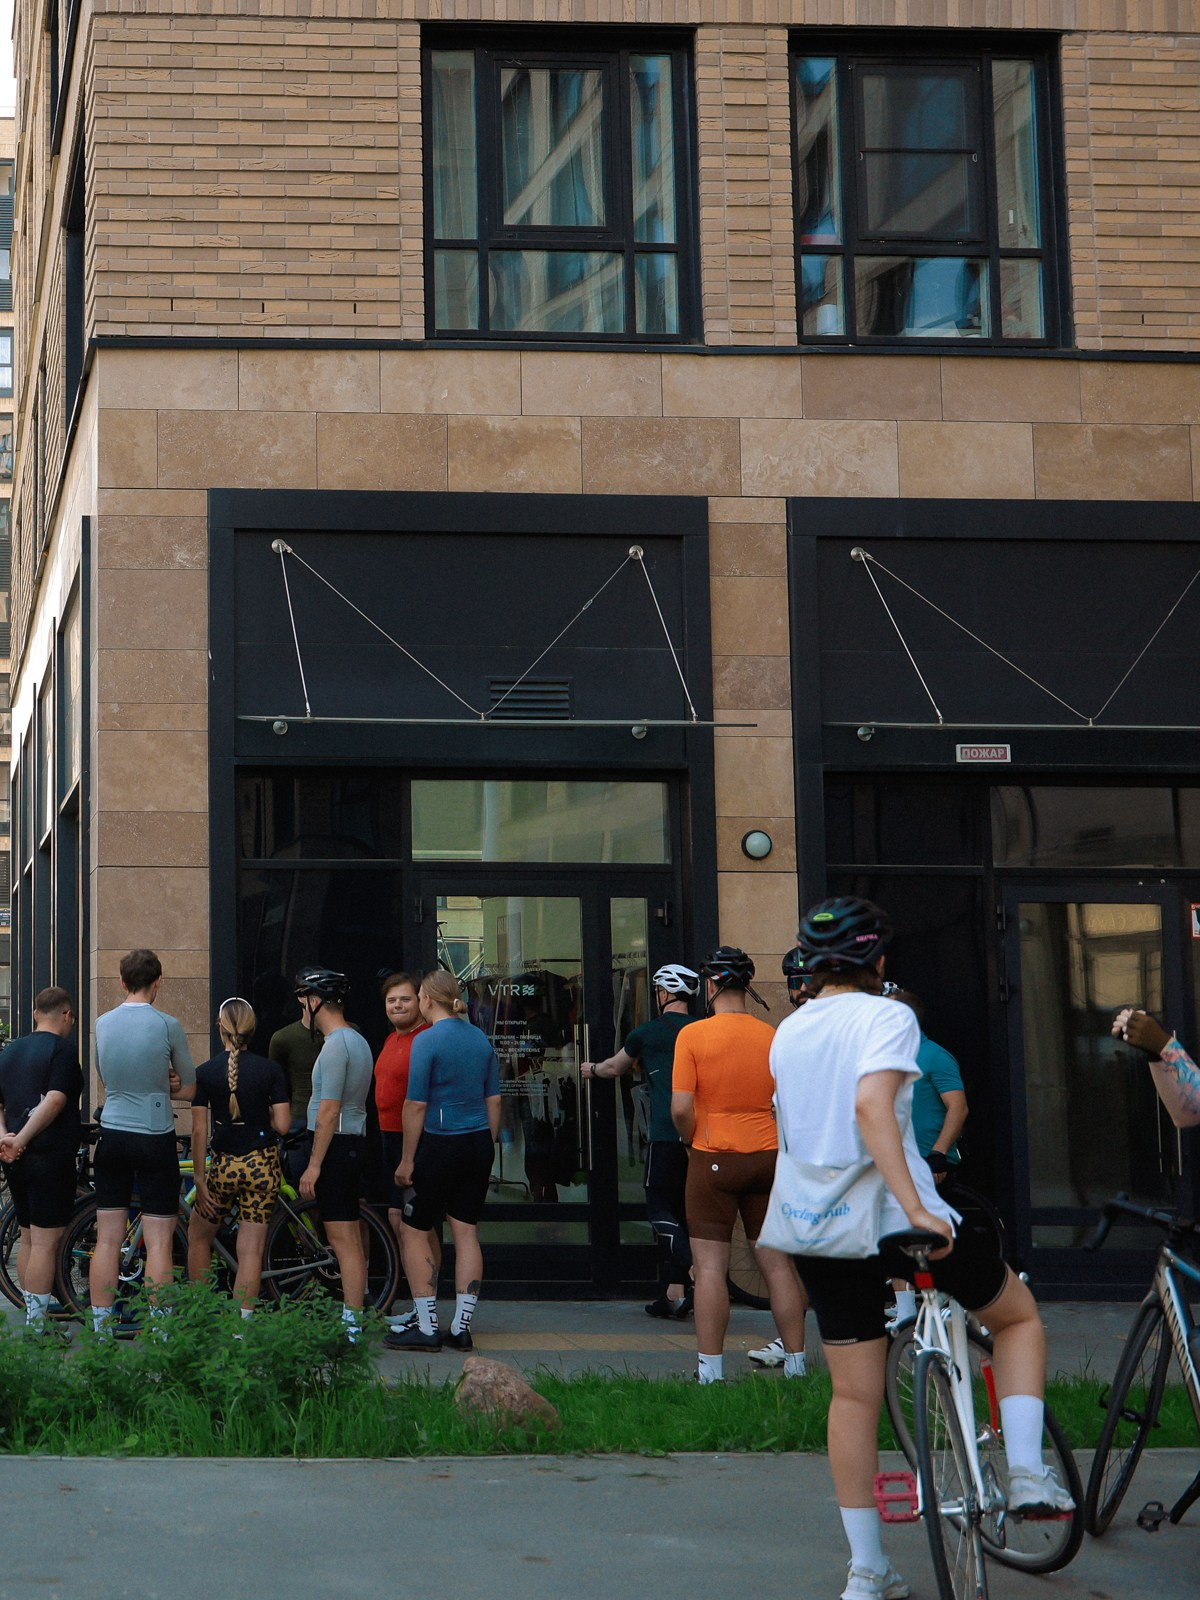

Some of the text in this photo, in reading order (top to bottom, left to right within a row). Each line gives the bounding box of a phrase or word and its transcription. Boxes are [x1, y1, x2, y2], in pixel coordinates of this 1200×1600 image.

[962, 748, 1005, 758] ПОЖАР
[488, 984, 520, 996] VTR
[781, 1202, 821, 1226] Cycling
[459, 1301, 477, 1332] HELL
